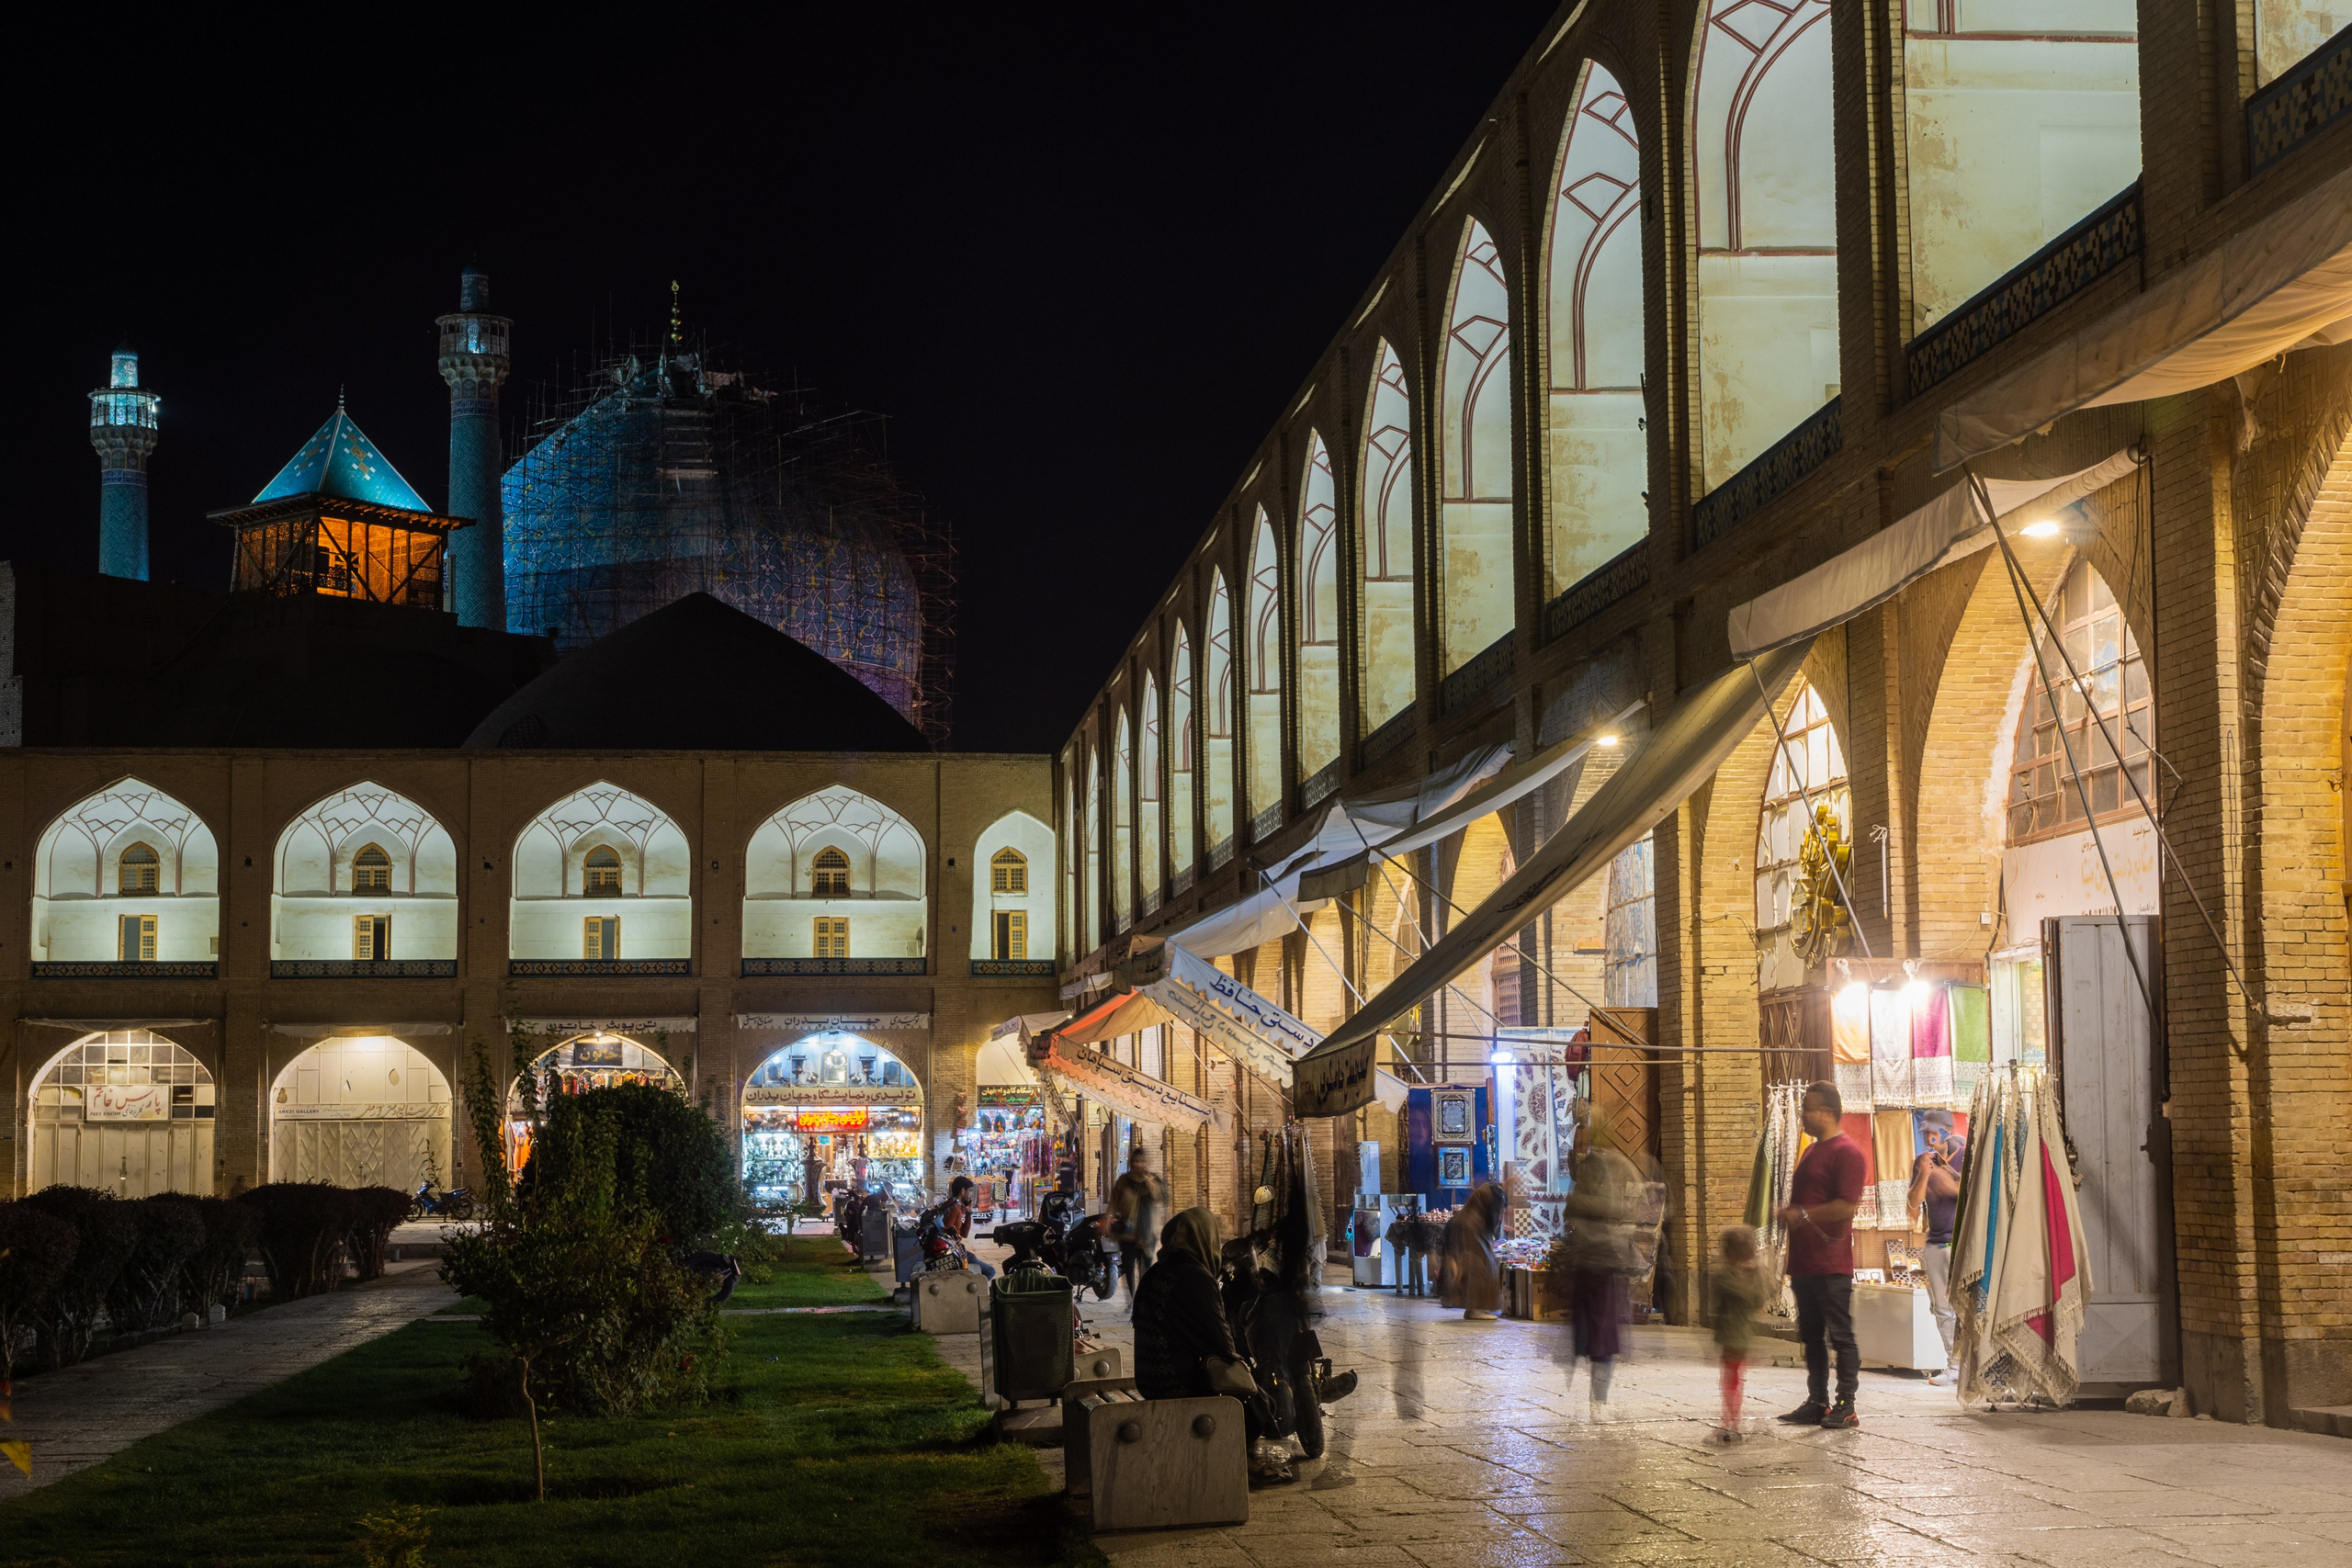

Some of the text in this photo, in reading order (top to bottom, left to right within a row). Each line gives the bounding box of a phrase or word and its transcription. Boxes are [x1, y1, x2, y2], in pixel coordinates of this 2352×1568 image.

[1209, 975, 1314, 1047] دستی حافظ
[831, 1015, 880, 1026] جهان
[579, 1046, 618, 1063] خاتون
[1077, 1049, 1212, 1116] صنایع دستی سپاهان
[93, 1086, 162, 1115] پارس خاتم
[745, 1089, 779, 1102] پدران
[780, 1089, 812, 1101] جهان
[870, 1089, 916, 1101] تولیدی
